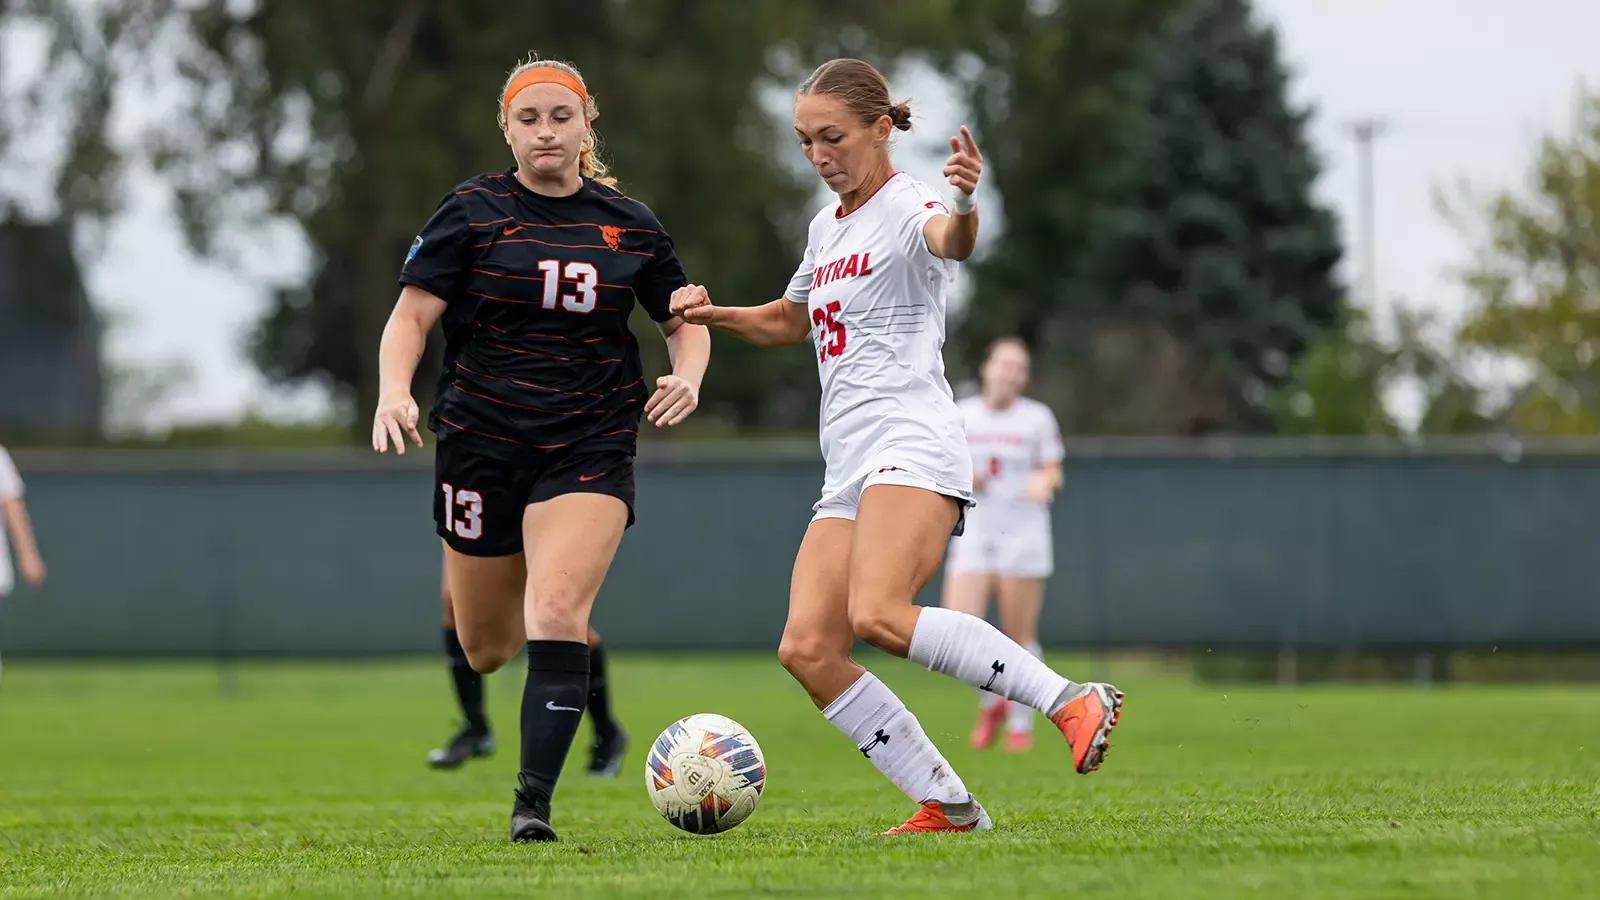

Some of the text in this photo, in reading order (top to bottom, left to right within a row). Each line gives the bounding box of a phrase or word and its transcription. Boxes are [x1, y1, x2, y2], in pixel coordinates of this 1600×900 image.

[537, 259, 598, 314] 13
[812, 300, 847, 364] 25
[441, 482, 483, 540] 13
[699, 779, 715, 797] NCAA
